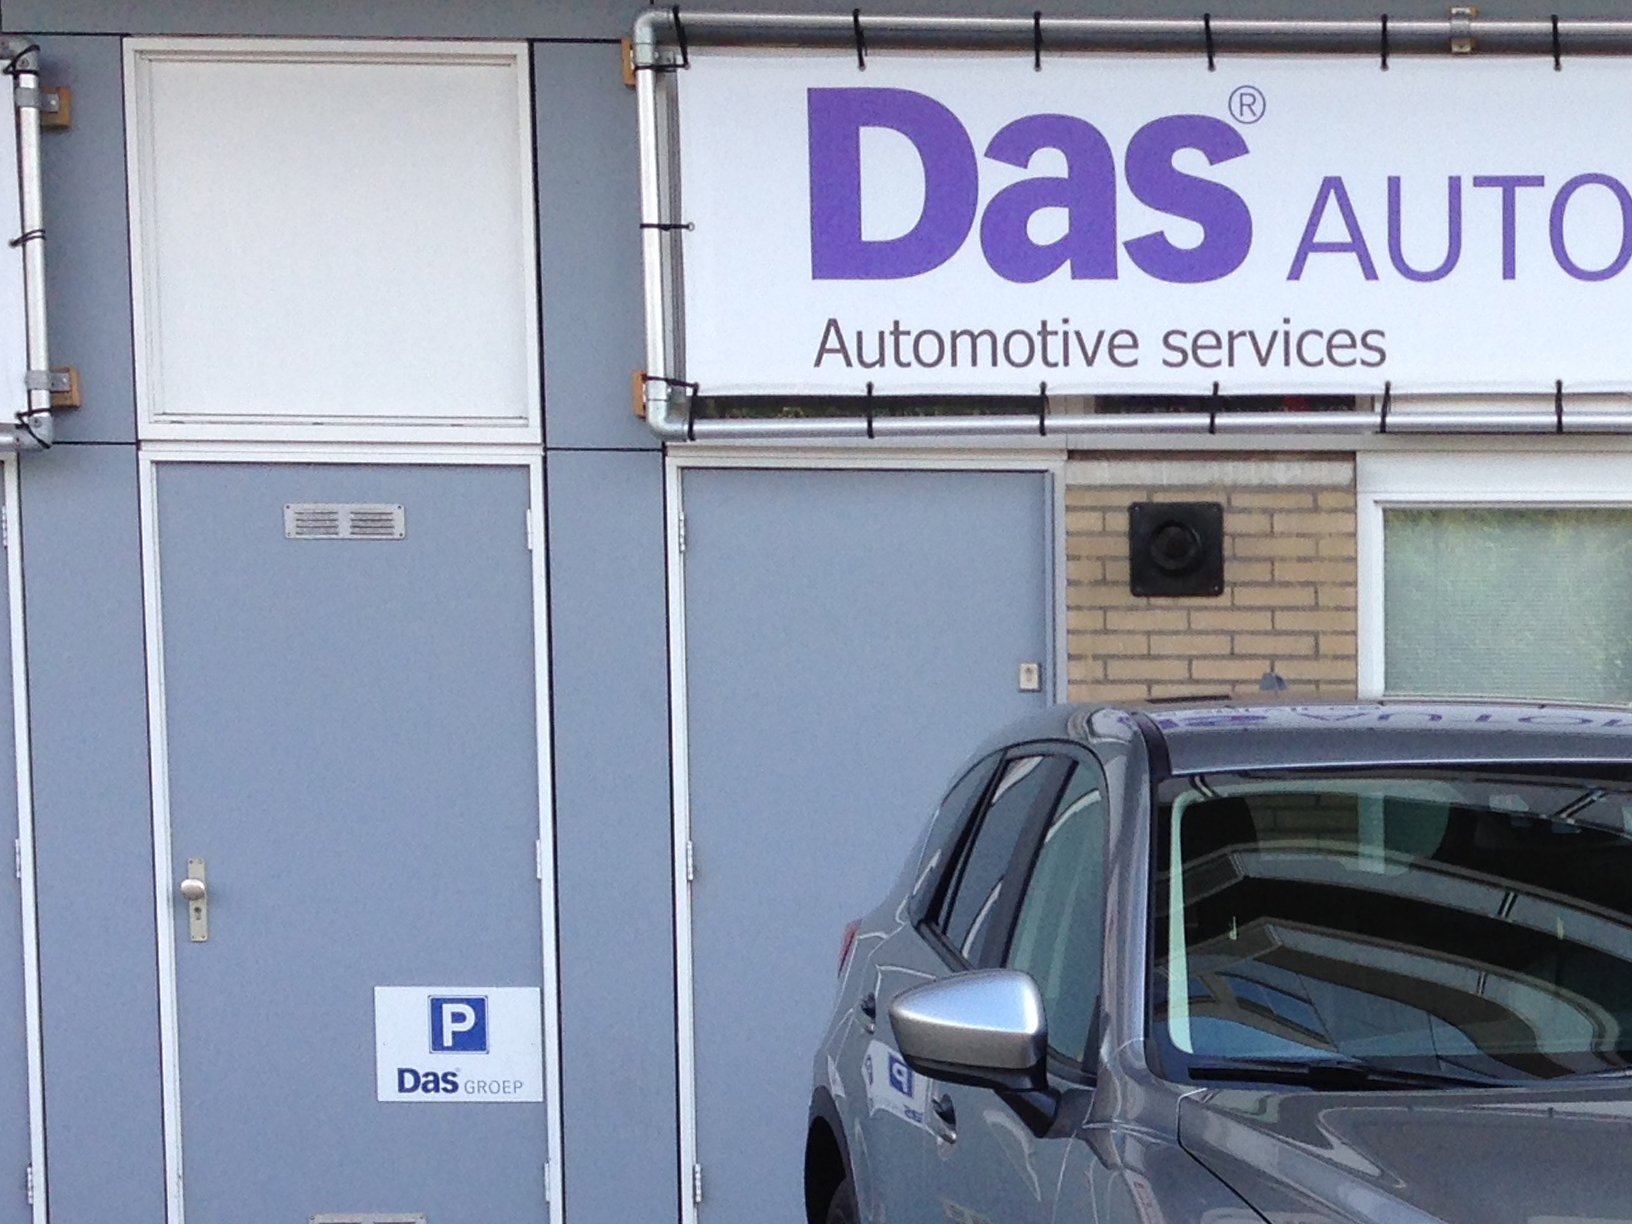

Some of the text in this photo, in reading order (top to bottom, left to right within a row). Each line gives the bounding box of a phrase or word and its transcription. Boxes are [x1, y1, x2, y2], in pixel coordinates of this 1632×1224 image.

[814, 318, 1388, 369] Automotive services
[442, 1003, 476, 1047] P
[397, 1067, 524, 1095] Das GROEP
